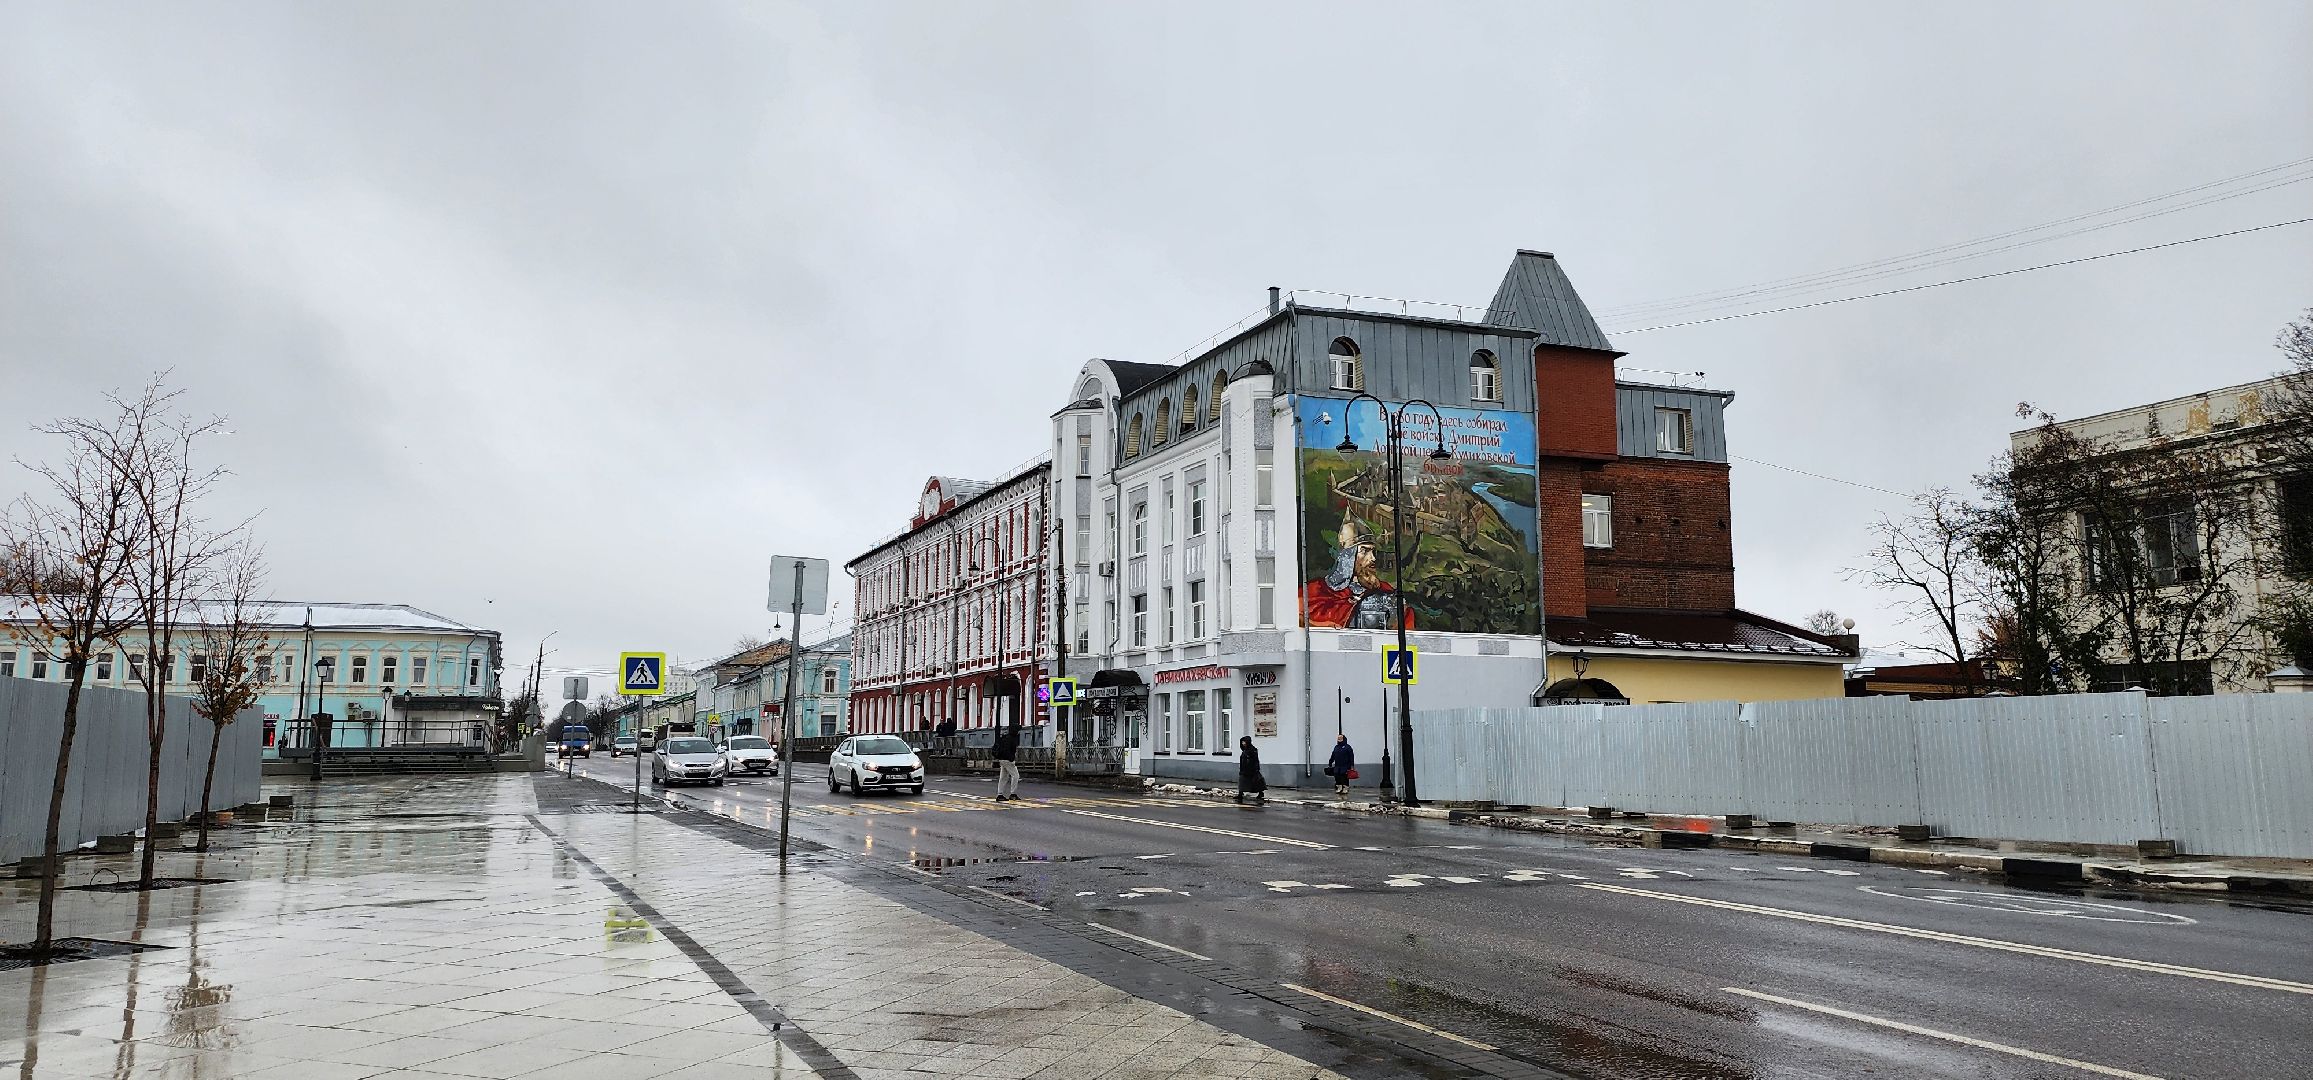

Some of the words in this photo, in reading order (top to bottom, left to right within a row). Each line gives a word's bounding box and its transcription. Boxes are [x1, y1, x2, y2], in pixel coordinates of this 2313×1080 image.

[1413, 413, 1435, 430] году
[1466, 412, 1508, 434] собирал
[1448, 430, 1500, 451] Дмитрий
[1373, 439, 1417, 457] Донкой
[1451, 445, 1516, 465] Куликовской
